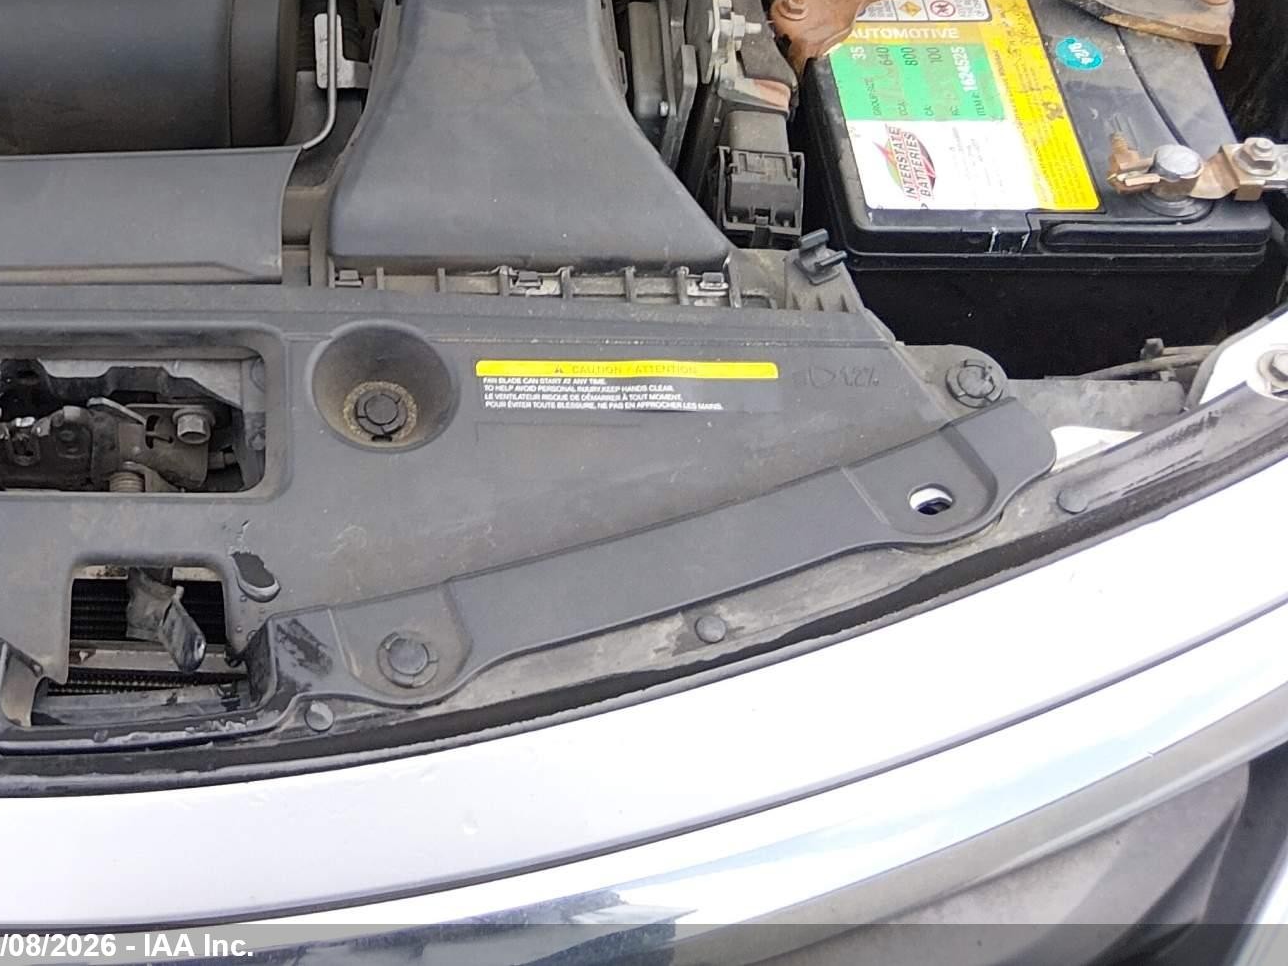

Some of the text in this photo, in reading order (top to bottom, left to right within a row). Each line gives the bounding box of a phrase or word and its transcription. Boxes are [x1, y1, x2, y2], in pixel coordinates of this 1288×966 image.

[850, 45, 867, 61] 35
[875, 46, 894, 67] 640
[900, 46, 919, 67] 800
[926, 46, 943, 64] 100
[887, 125, 919, 200] INTERSTATE
[903, 130, 932, 198] BATTERIES
[571, 365, 622, 375] CAUTION
[495, 384, 514, 392] HELP
[621, 385, 648, 393] HANDS
[522, 377, 539, 385] CAN
